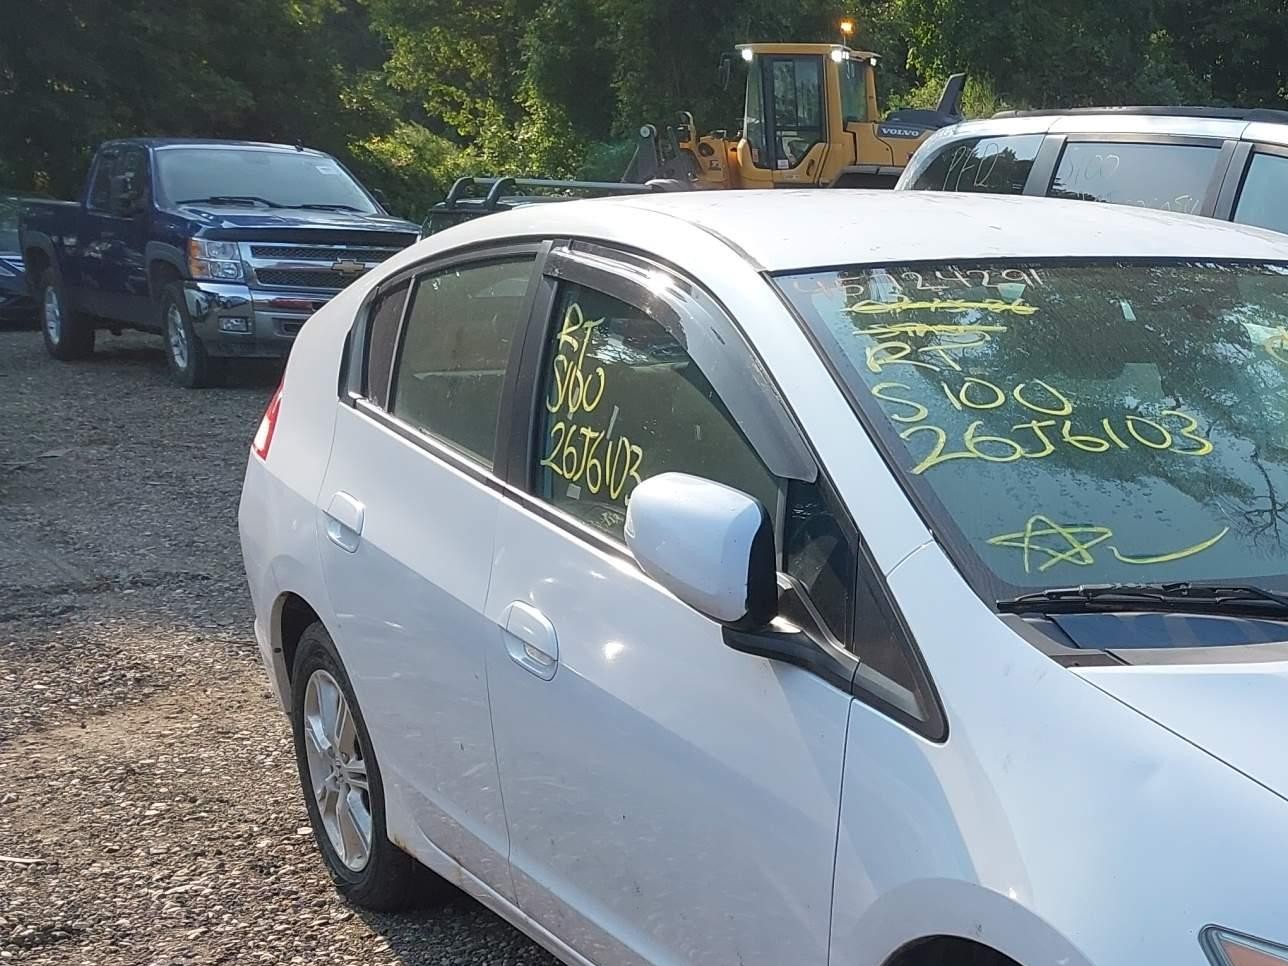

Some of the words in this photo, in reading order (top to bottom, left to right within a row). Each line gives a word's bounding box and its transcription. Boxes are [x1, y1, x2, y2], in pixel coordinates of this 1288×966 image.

[881, 127, 920, 137] VOLVO
[556, 303, 606, 370] RT
[866, 331, 991, 373] RT
[900, 410, 1214, 475] 26J6103
